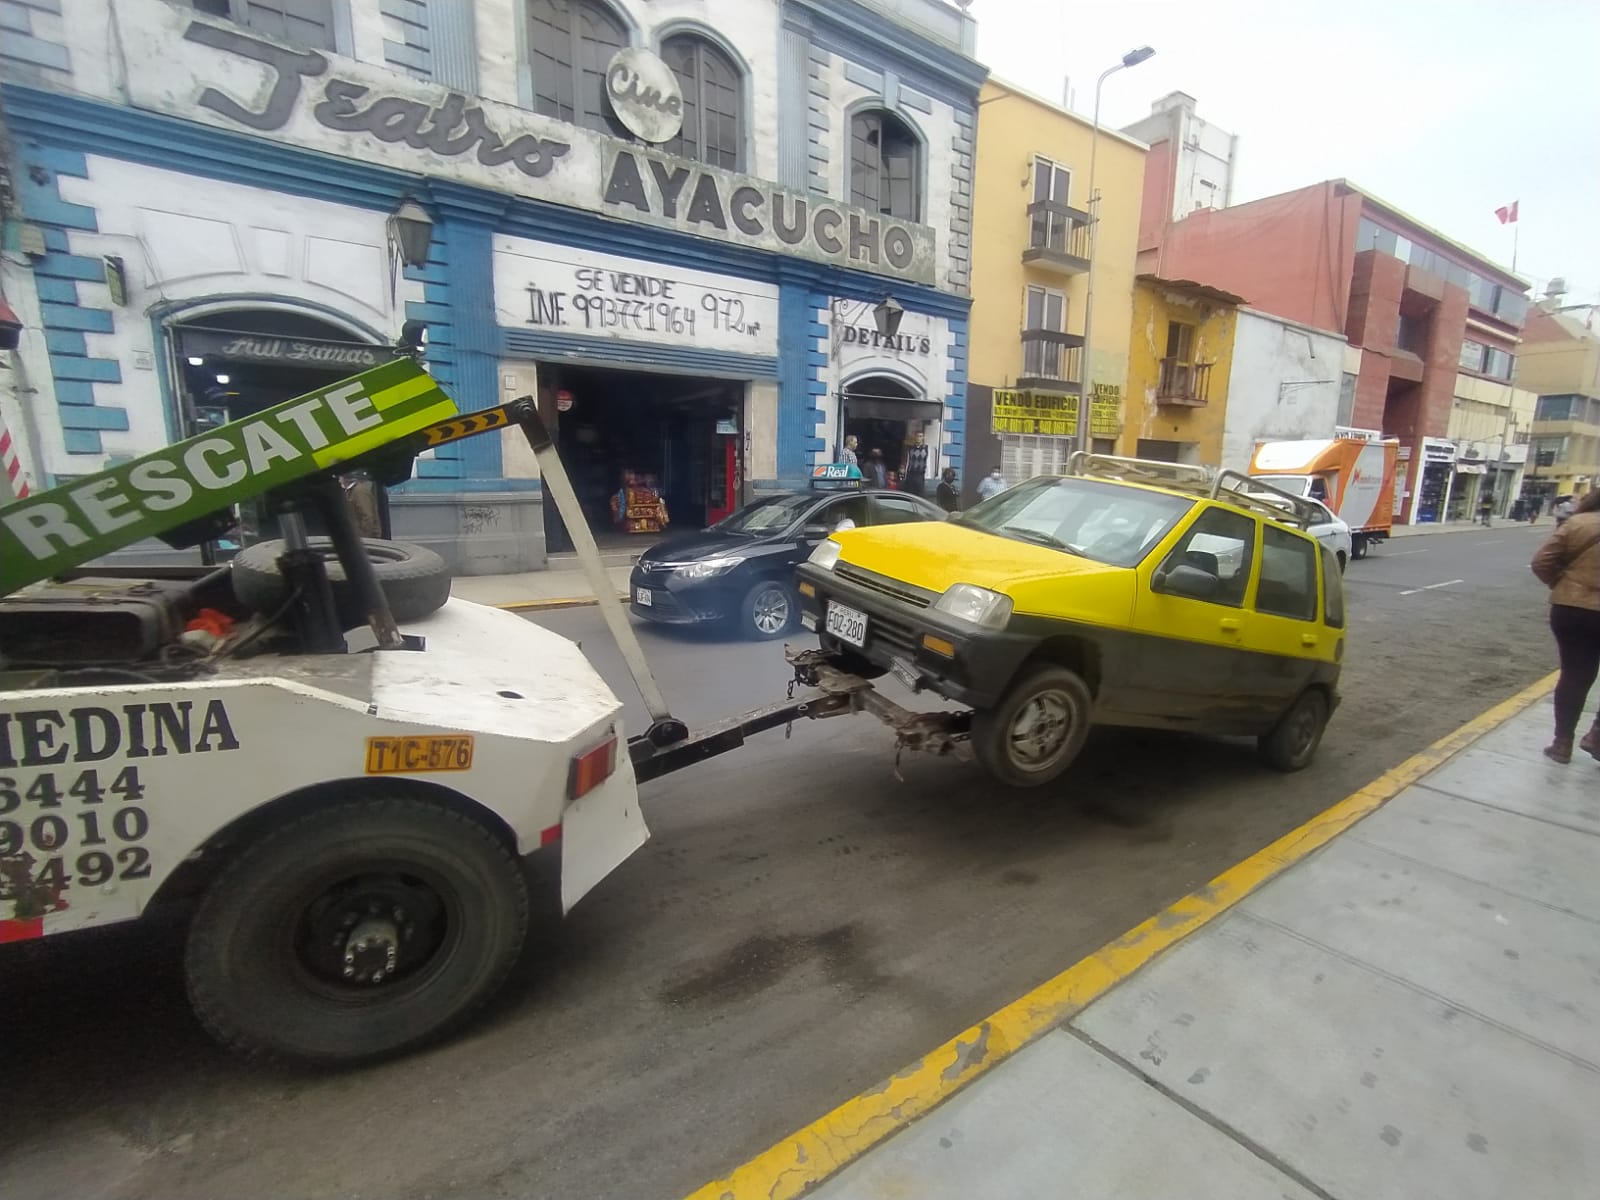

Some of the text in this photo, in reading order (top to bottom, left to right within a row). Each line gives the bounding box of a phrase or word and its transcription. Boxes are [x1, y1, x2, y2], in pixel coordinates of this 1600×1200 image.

[183, 20, 570, 178] Teatro
[608, 64, 681, 116] Cine
[603, 151, 914, 268] AYACUCHO
[575, 269, 676, 300] SE VENDE
[994, 391, 1033, 407] VENDO
[1035, 394, 1077, 411] EDIFICIO
[2, 381, 383, 561] RESCATE
[827, 465, 849, 478] Real
